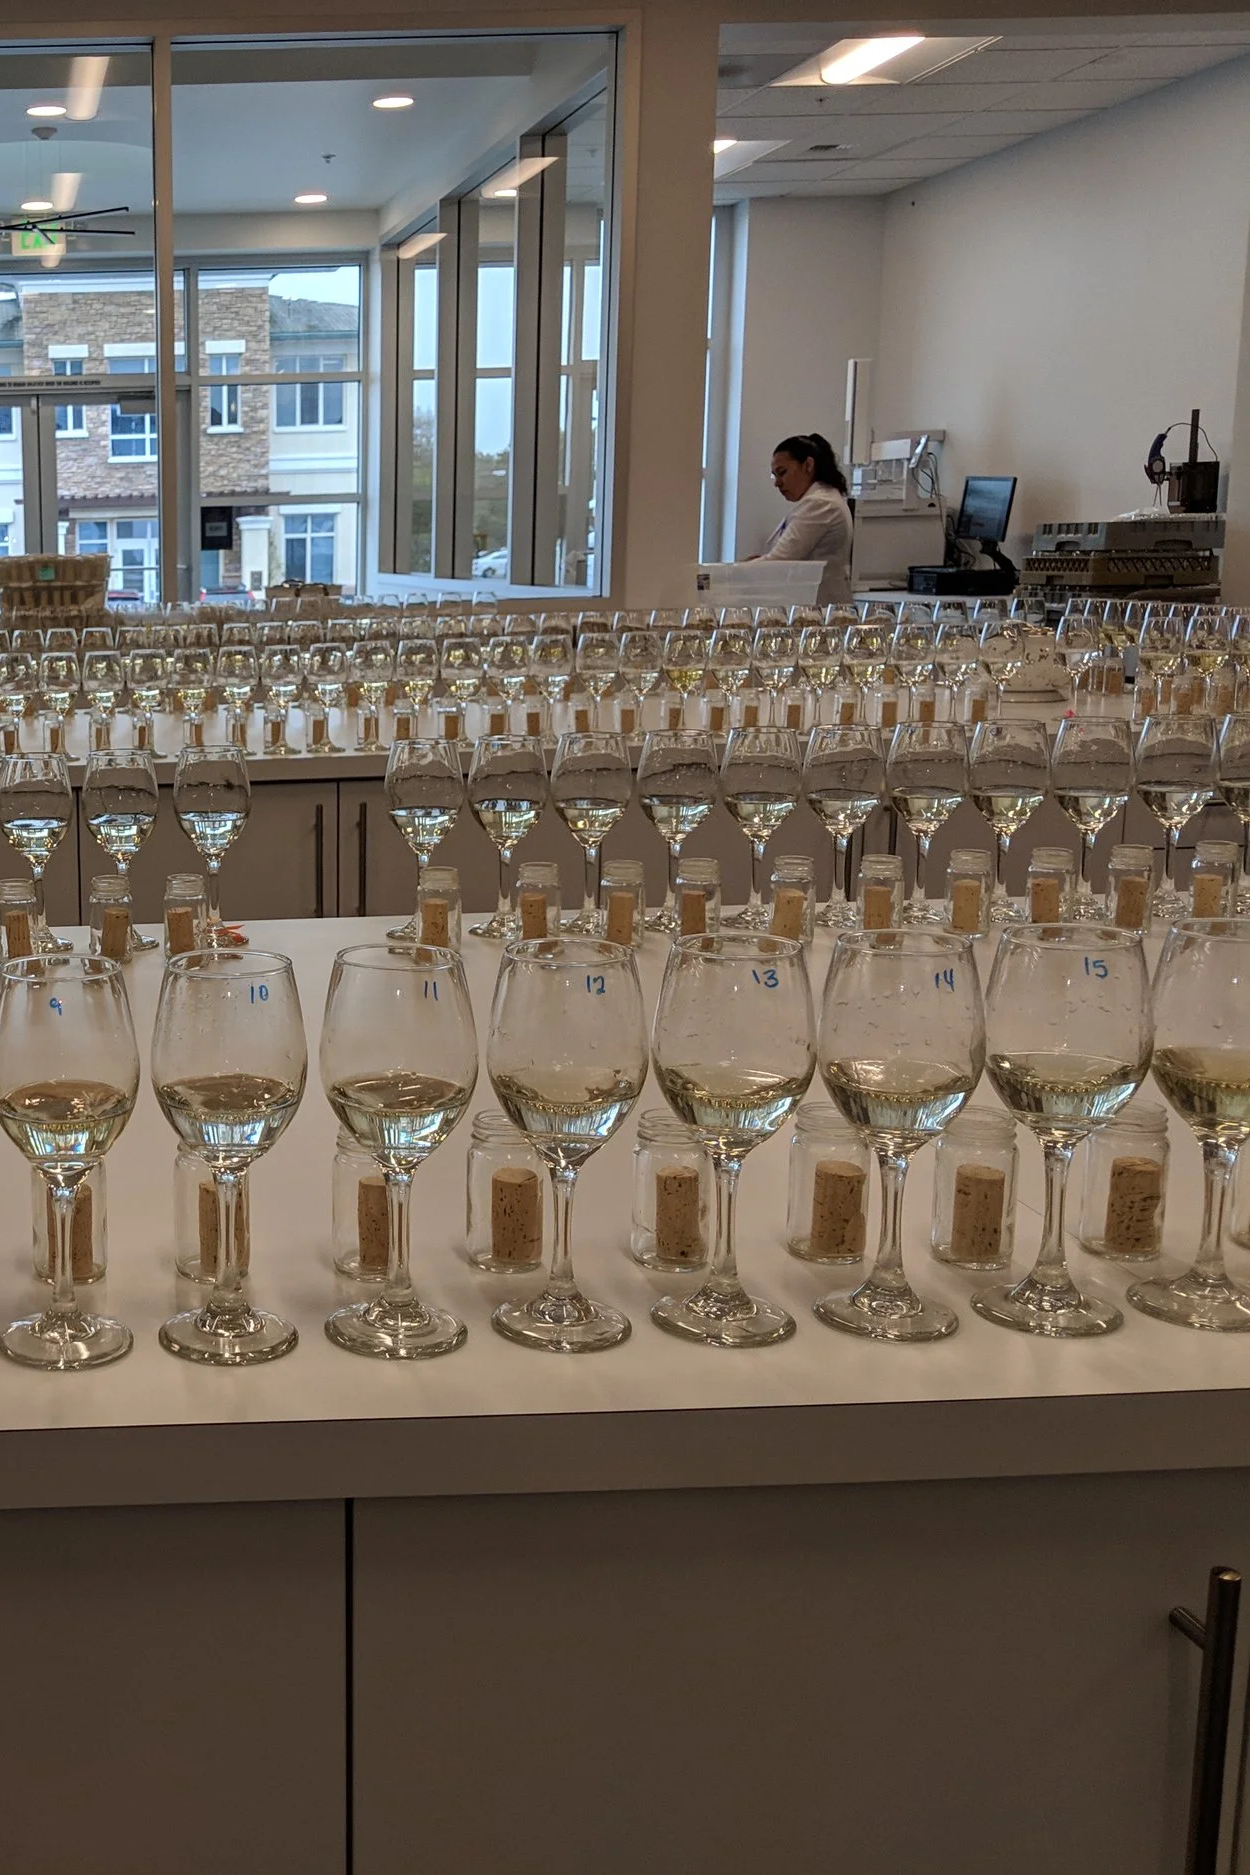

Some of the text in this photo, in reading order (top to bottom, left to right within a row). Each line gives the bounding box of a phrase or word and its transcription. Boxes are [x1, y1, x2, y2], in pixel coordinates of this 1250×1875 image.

[1085, 957, 1110, 980] 15
[584, 975, 607, 995] 12
[753, 970, 781, 990] 13
[935, 969, 957, 992] 14
[249, 984, 270, 1004] 10
[423, 980, 440, 1001] 11
[50, 997, 64, 1016] 9
